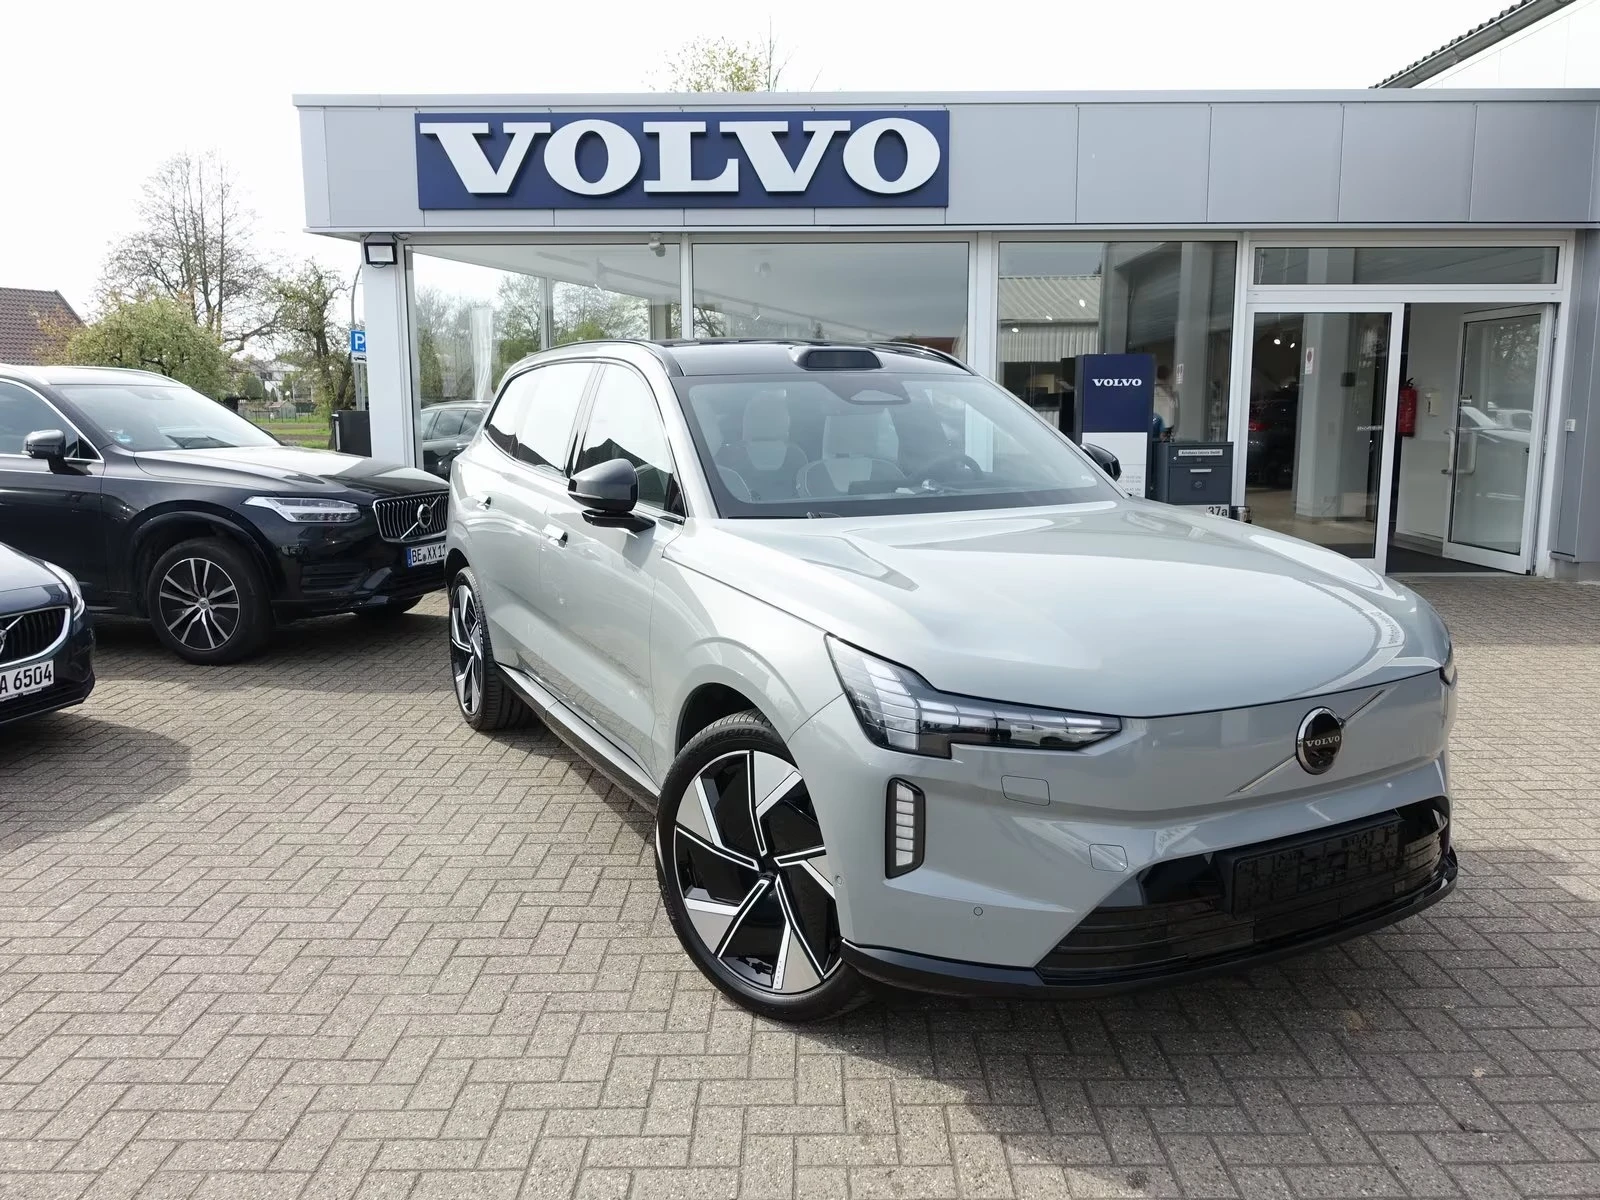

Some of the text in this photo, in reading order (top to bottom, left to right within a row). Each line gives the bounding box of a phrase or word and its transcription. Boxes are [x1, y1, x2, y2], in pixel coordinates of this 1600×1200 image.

[419, 118, 941, 196] VOLVO
[354, 333, 365, 350] P
[1092, 378, 1142, 387] VOLVO
[1208, 506, 1228, 516] 37a
[412, 549, 422, 563] BE
[14, 664, 52, 690] 6504
[1306, 735, 1340, 747] VOLVO
